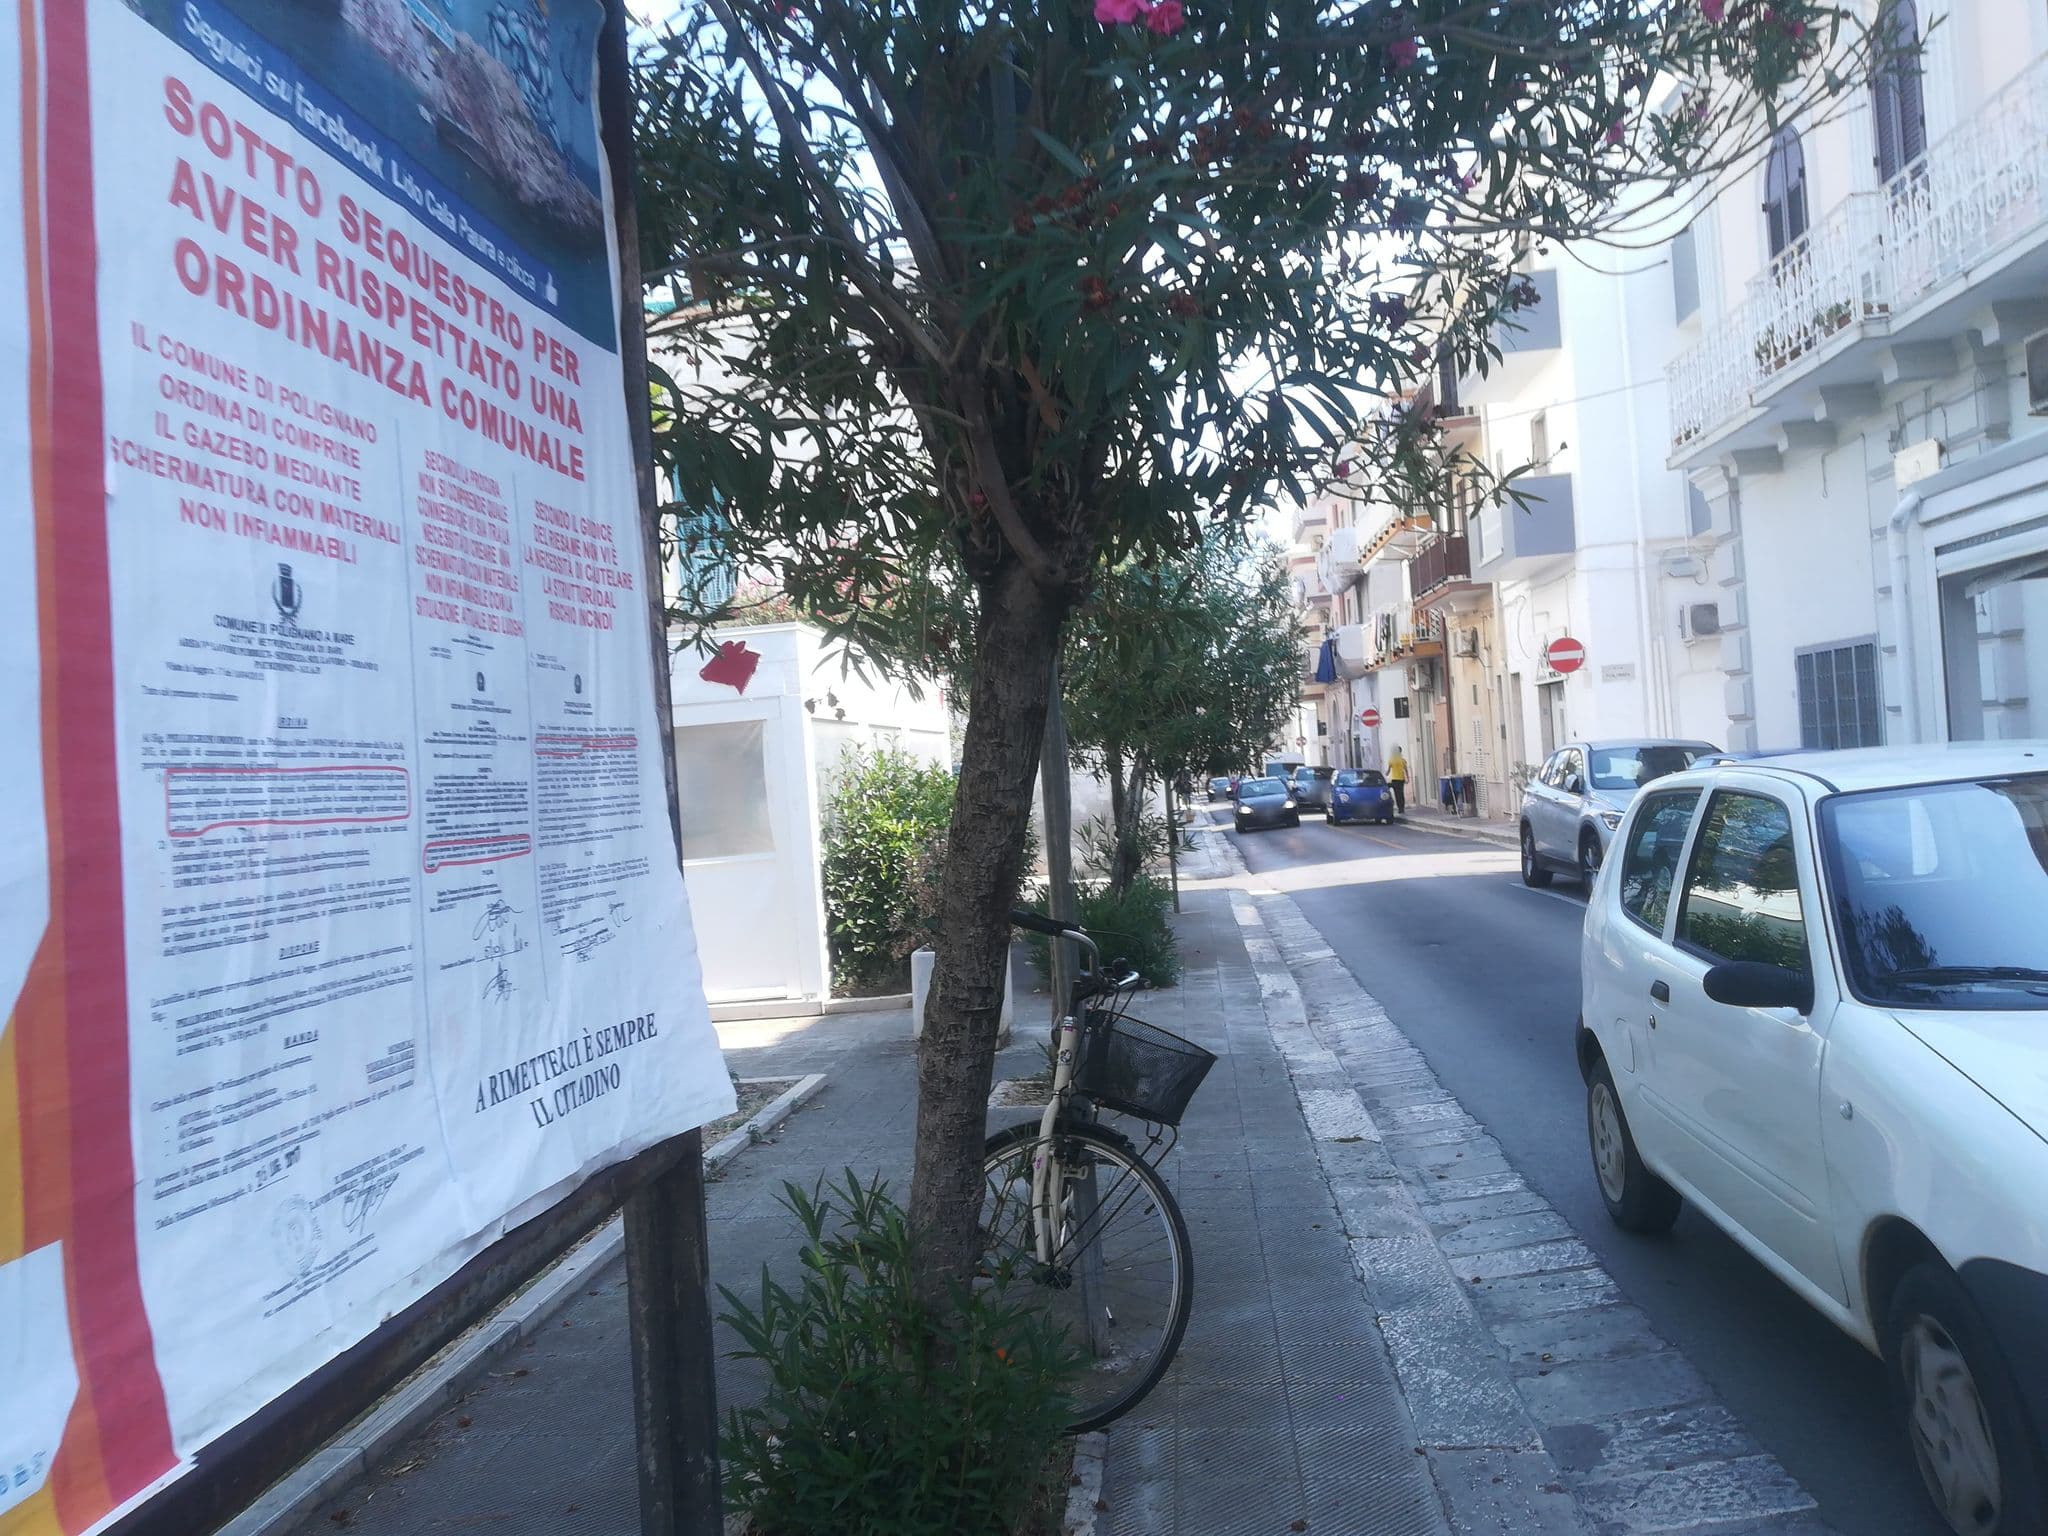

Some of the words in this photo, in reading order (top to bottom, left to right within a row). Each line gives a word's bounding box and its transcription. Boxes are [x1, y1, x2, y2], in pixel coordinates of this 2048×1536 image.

[183, 1, 263, 85] Seguici
[264, 70, 295, 105] su
[295, 81, 384, 180] facebook
[163, 75, 323, 218] SOTTO
[338, 193, 524, 350] SEQUESTRO
[532, 327, 581, 387] PER
[168, 156, 302, 276] AVER
[315, 238, 521, 400] RISPETTATO
[530, 375, 584, 435] UNA
[131, 320, 152, 352] IL
[158, 334, 249, 393] COMUNE
[255, 375, 274, 402] DI
[280, 385, 378, 444] POLIGNANO
[159, 372, 245, 425] ORDINA
[247, 405, 267, 435] DI
[173, 237, 432, 408] ORDINANZA
[440, 377, 585, 482] COMUNALE
[154, 410, 176, 441] IL
[183, 421, 269, 471] GAZEBO
[274, 451, 362, 502] MEDIANTE
[179, 497, 227, 533] NON
[273, 489, 315, 521] CON
[320, 501, 401, 545] MATERIALI
[213, 614, 257, 633] COMUNE
[475, 1080, 487, 1113] A
[583, 1028, 594, 1063] È
[596, 1012, 658, 1058] SEMPRE
[529, 1096, 554, 1129] IL
